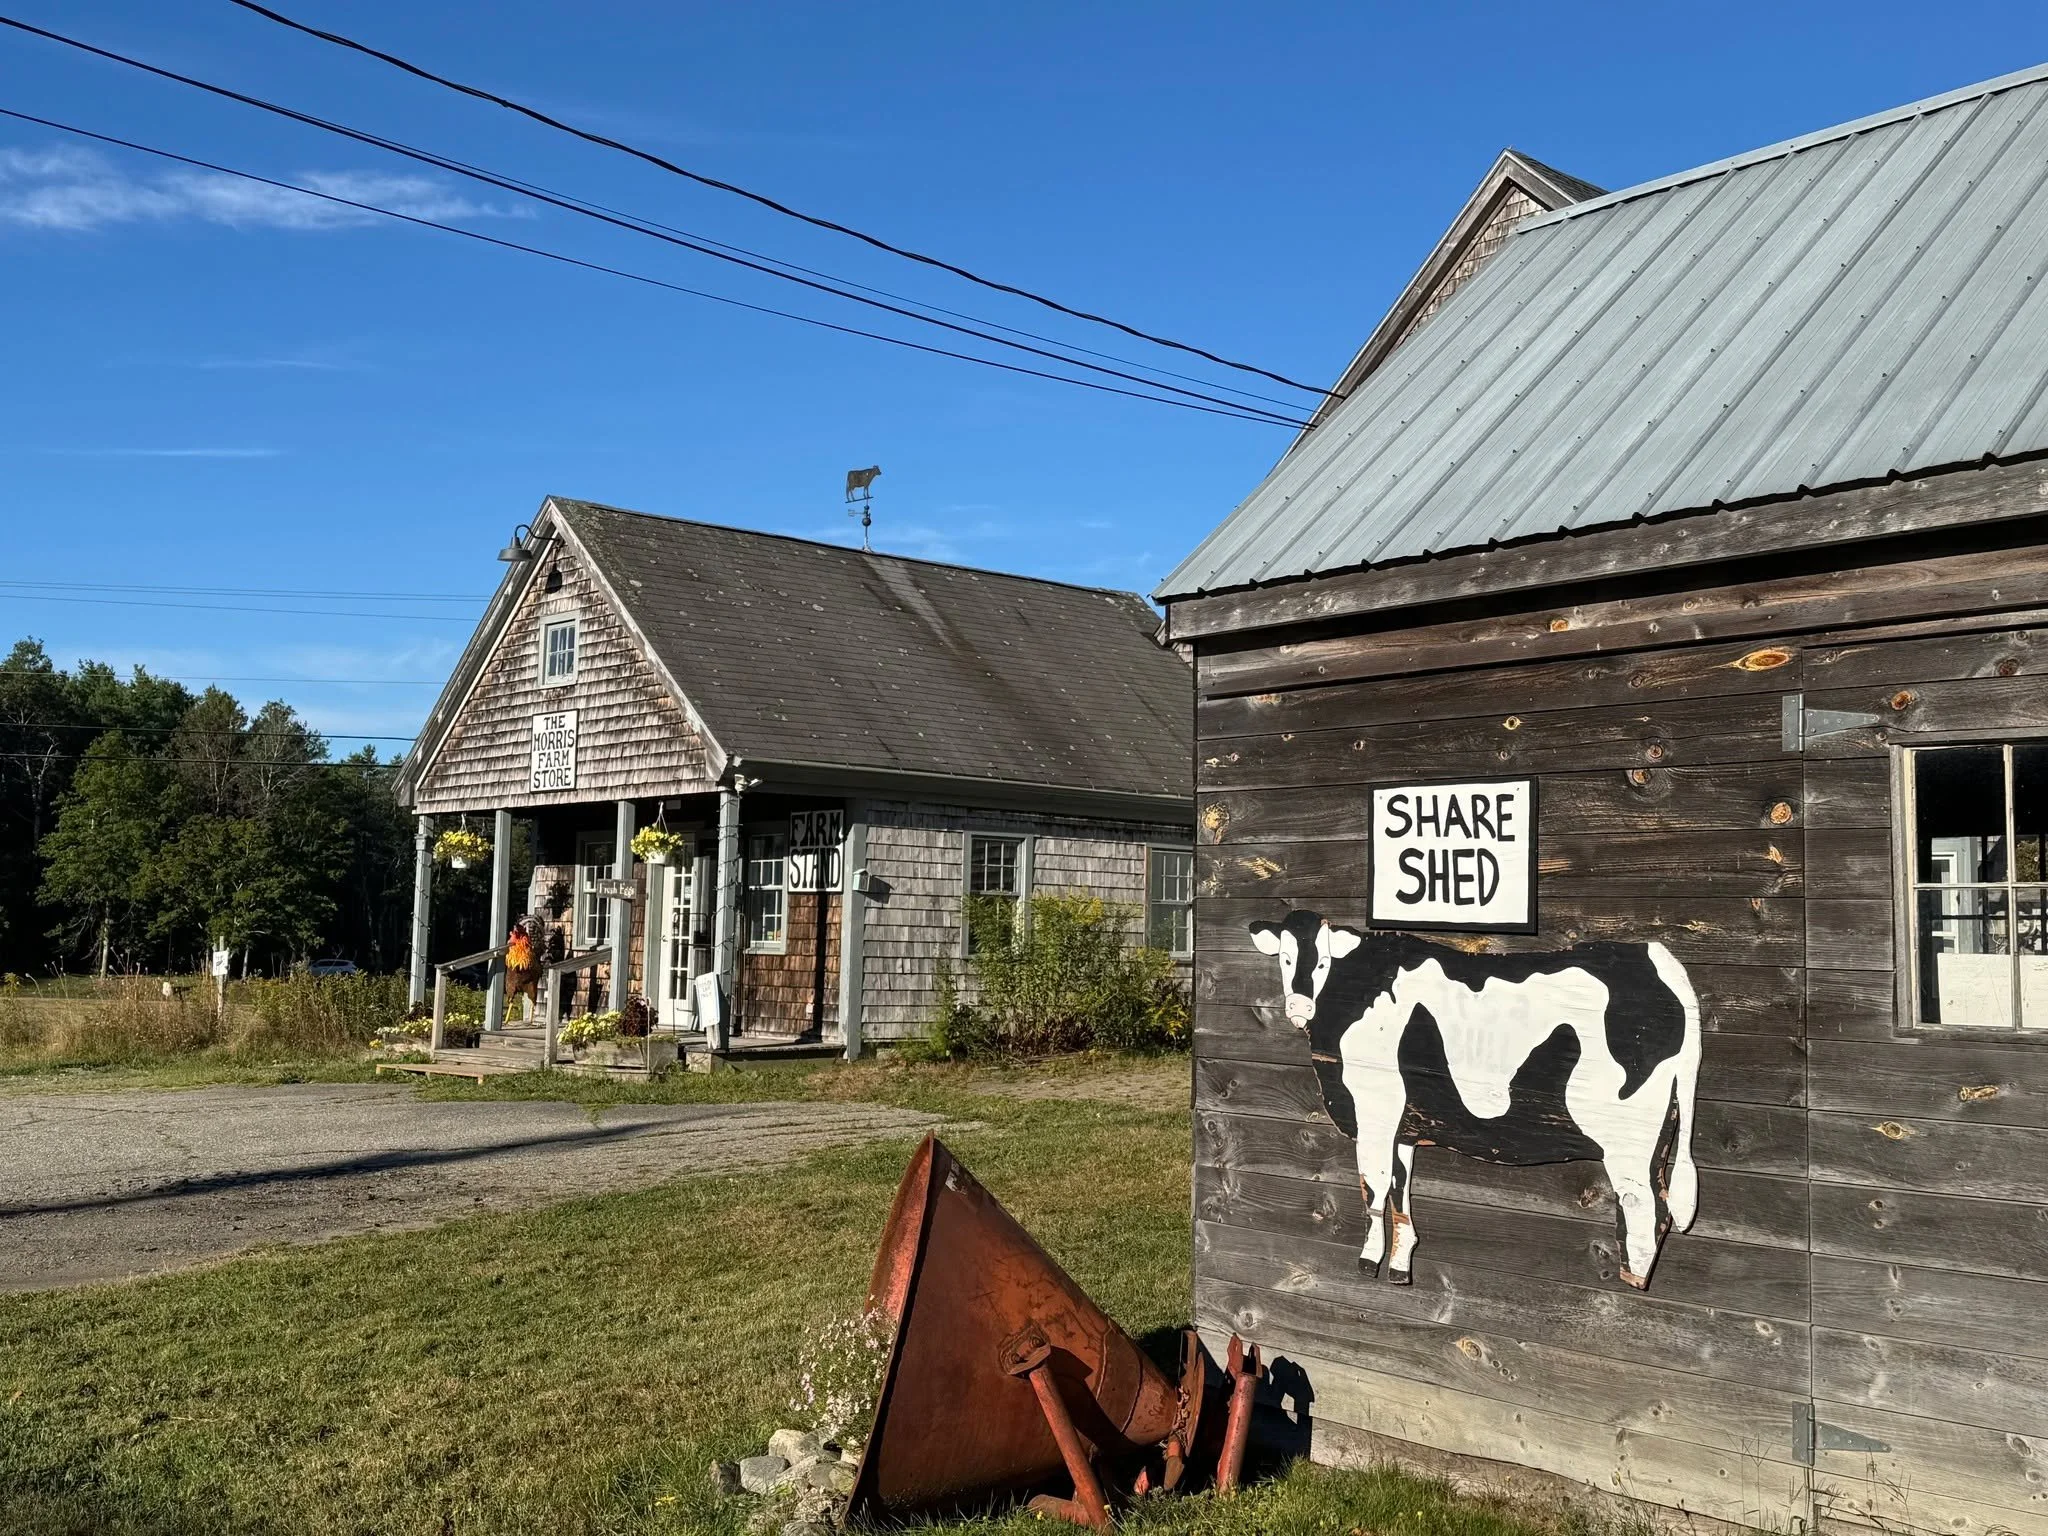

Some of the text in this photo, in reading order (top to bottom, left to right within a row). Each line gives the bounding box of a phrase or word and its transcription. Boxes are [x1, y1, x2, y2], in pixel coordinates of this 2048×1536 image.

[544, 715, 566, 730] THE
[533, 729, 575, 752] MORRIS
[538, 749, 570, 769] FARM
[533, 768, 571, 788] STORE
[791, 812, 841, 846] FARM
[1385, 794, 1515, 841] SHARE
[790, 847, 841, 889] STAND
[1395, 847, 1500, 906] SHED
